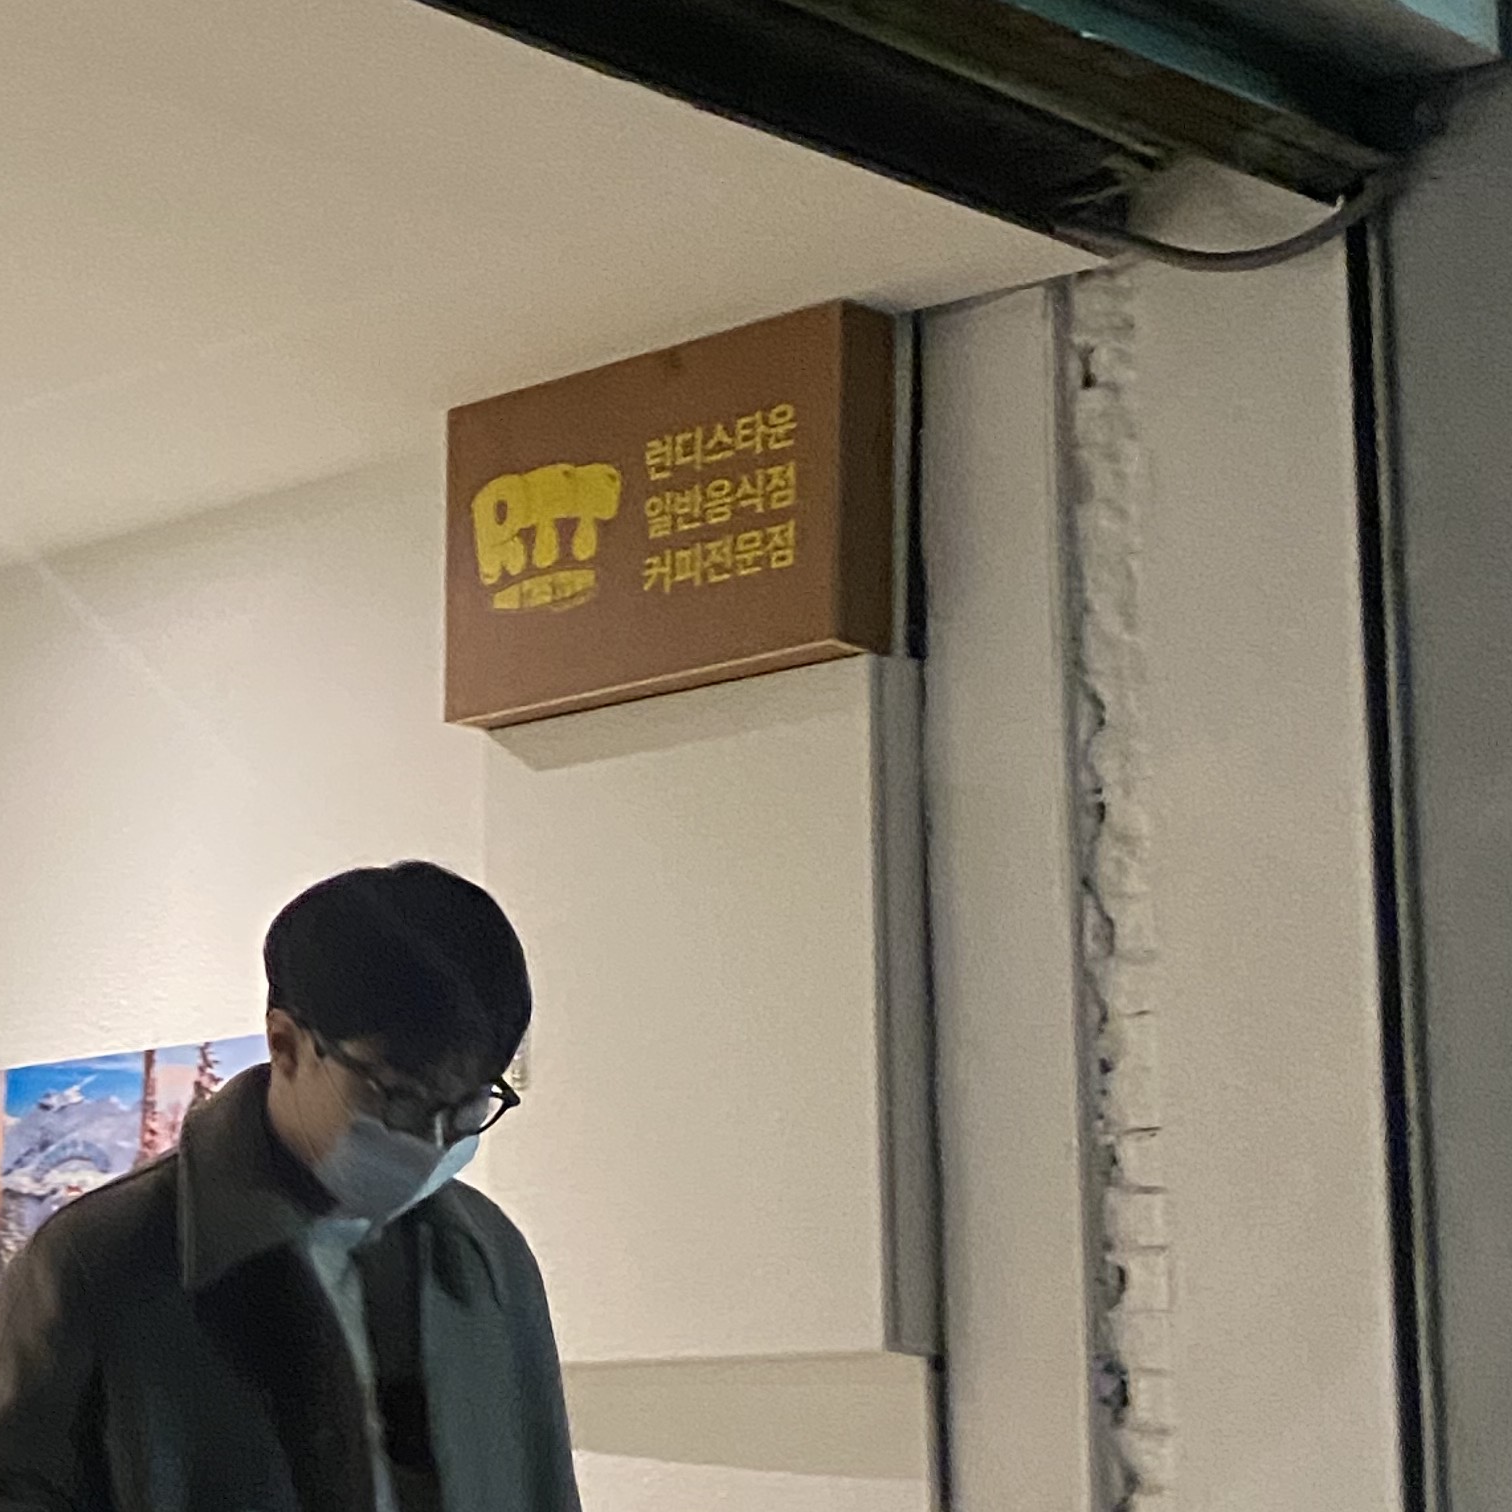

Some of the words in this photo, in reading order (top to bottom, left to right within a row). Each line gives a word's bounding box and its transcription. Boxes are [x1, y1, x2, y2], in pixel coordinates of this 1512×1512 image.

[645, 404, 797, 481] 런디스타운
[644, 462, 796, 539] 일반음식점
[643, 519, 796, 594] 커피전문점
